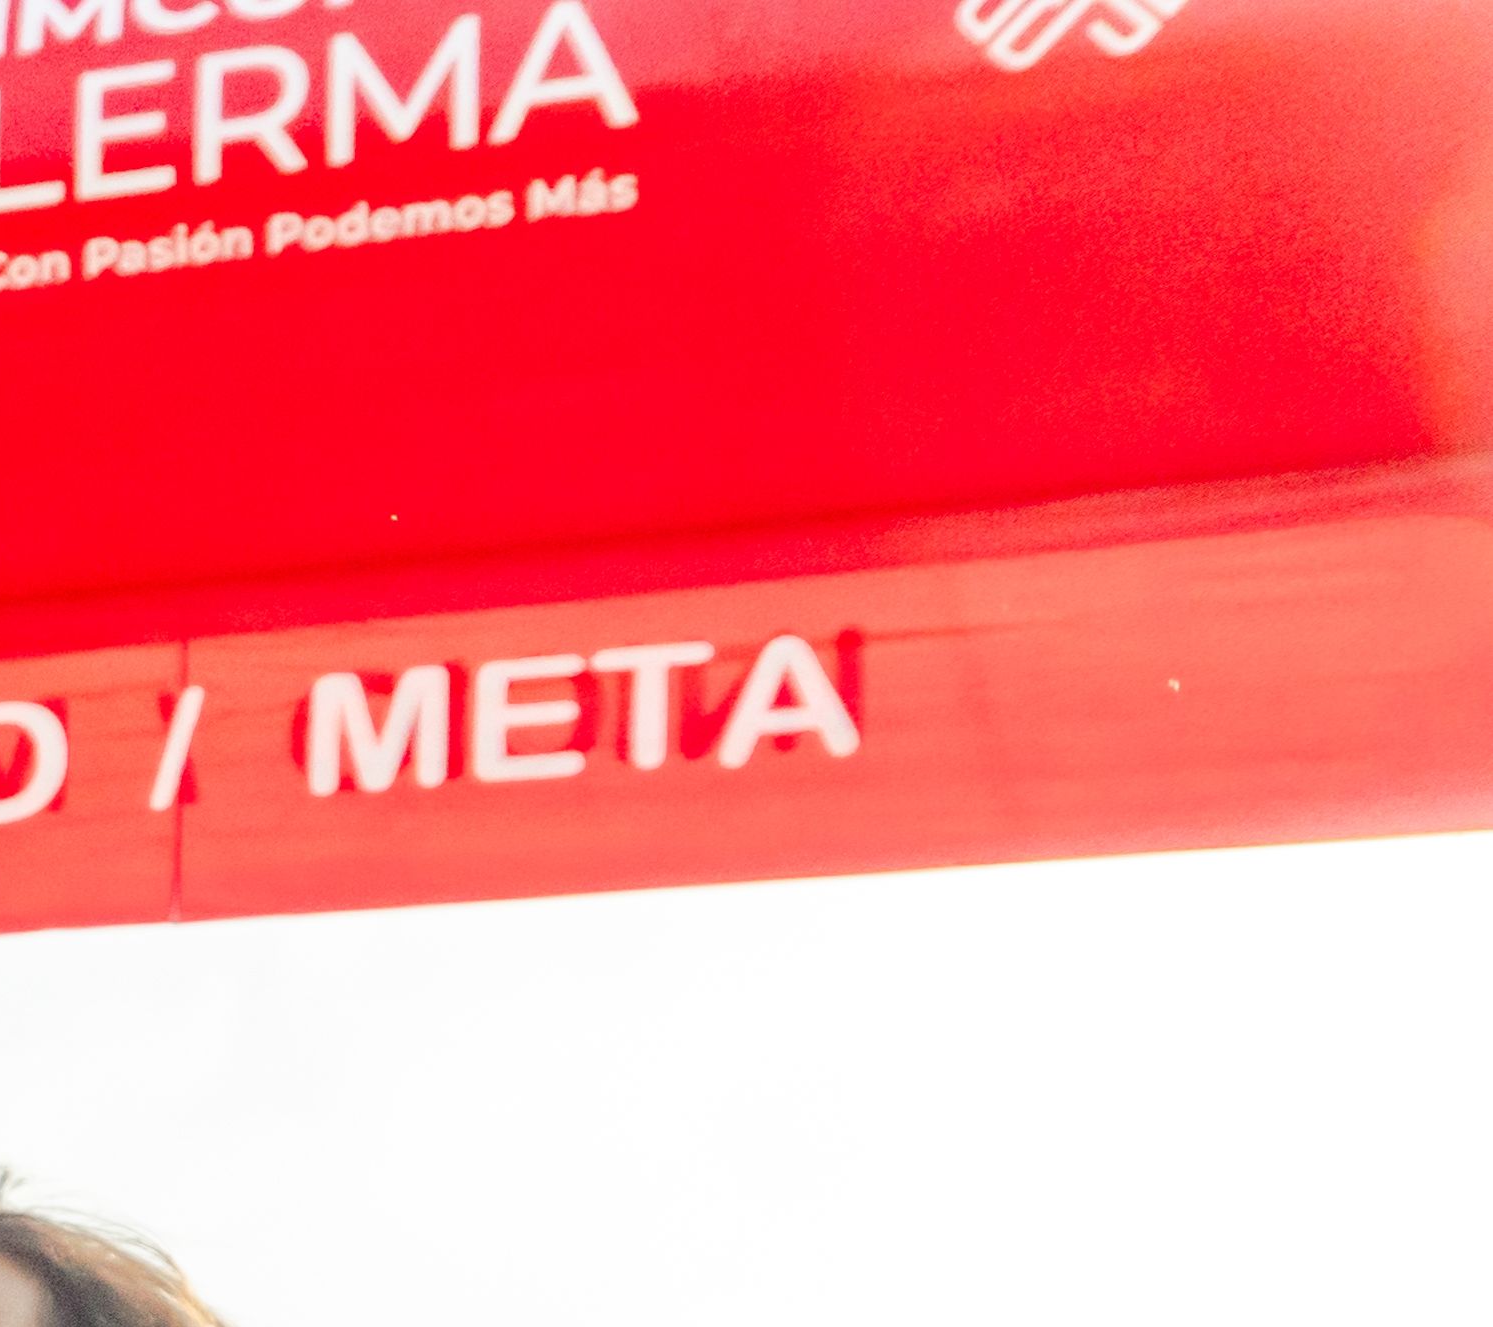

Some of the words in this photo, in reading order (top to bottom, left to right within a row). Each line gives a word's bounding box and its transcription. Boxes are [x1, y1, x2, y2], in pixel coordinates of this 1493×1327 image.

[82, 221, 253, 280] Pasión
[264, 189, 514, 257] Podemos
[526, 167, 640, 223] Más
[150, 685, 205, 811] /
[306, 632, 861, 798] META
